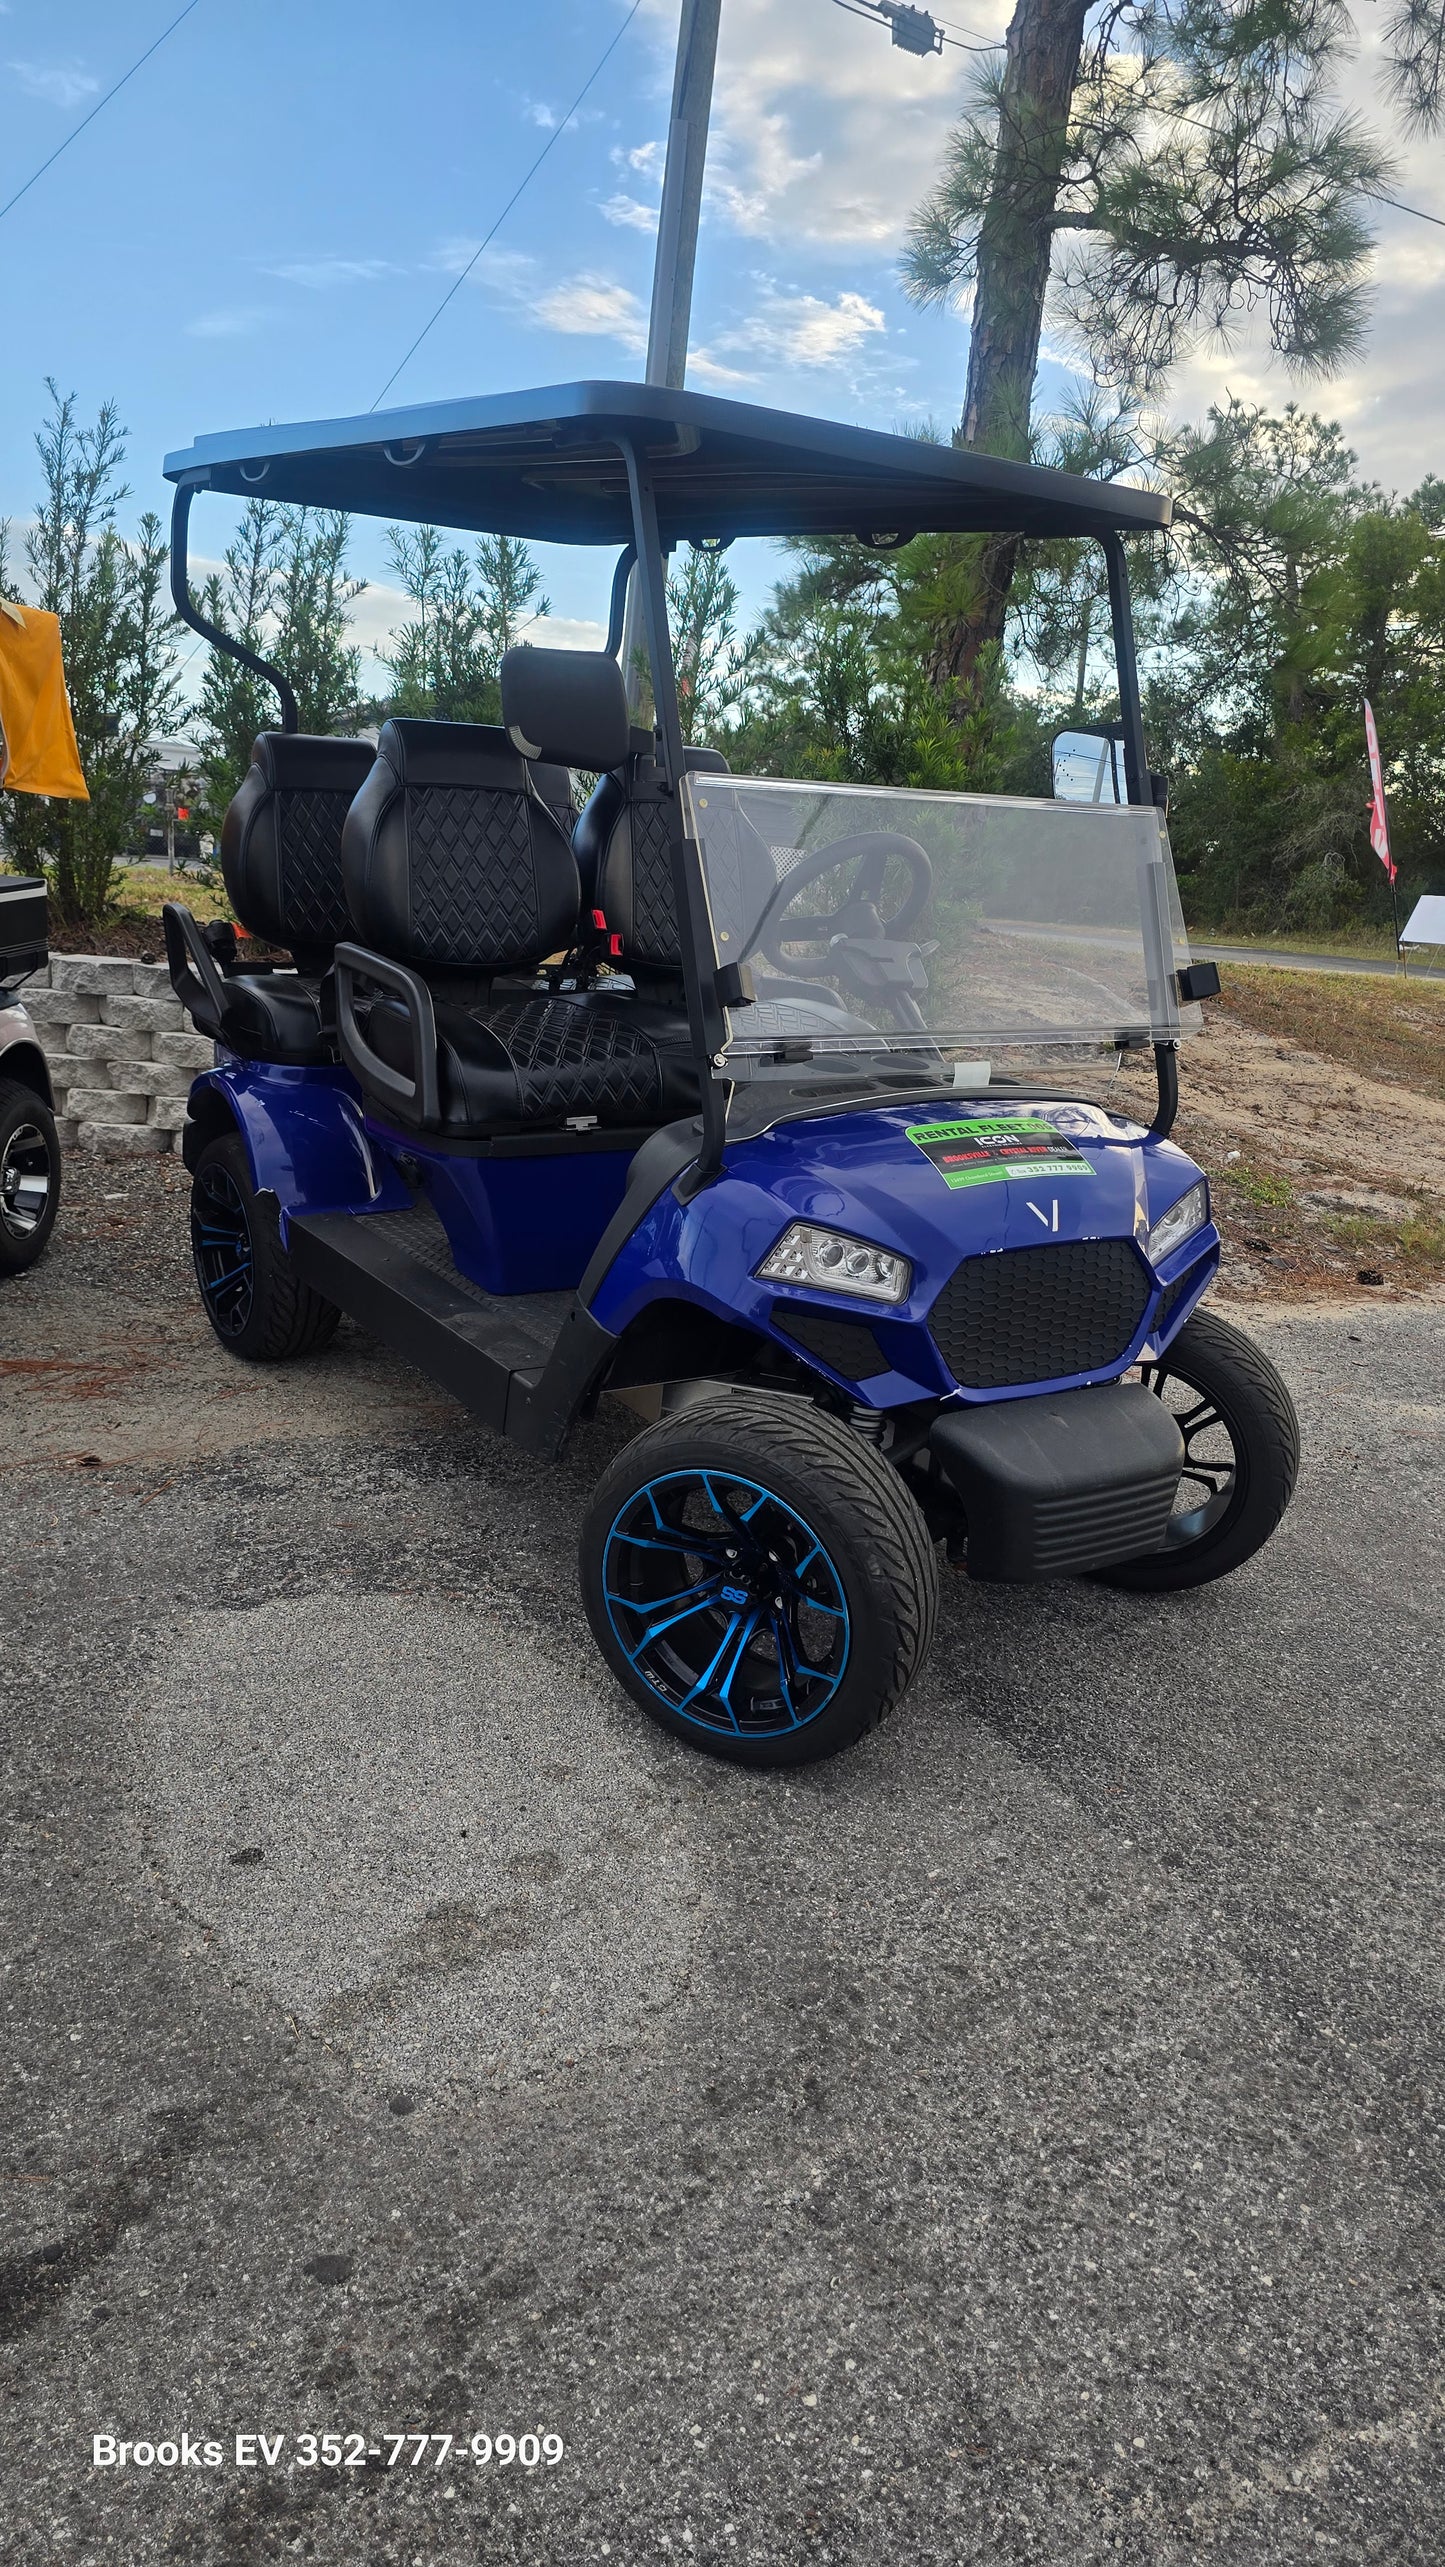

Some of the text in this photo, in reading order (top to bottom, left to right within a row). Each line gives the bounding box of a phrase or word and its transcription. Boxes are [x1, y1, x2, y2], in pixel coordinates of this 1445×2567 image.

[913, 1127, 980, 1141] RENTAL
[978, 1122, 1026, 1133] FLEET
[974, 1135, 1019, 1146] ICON
